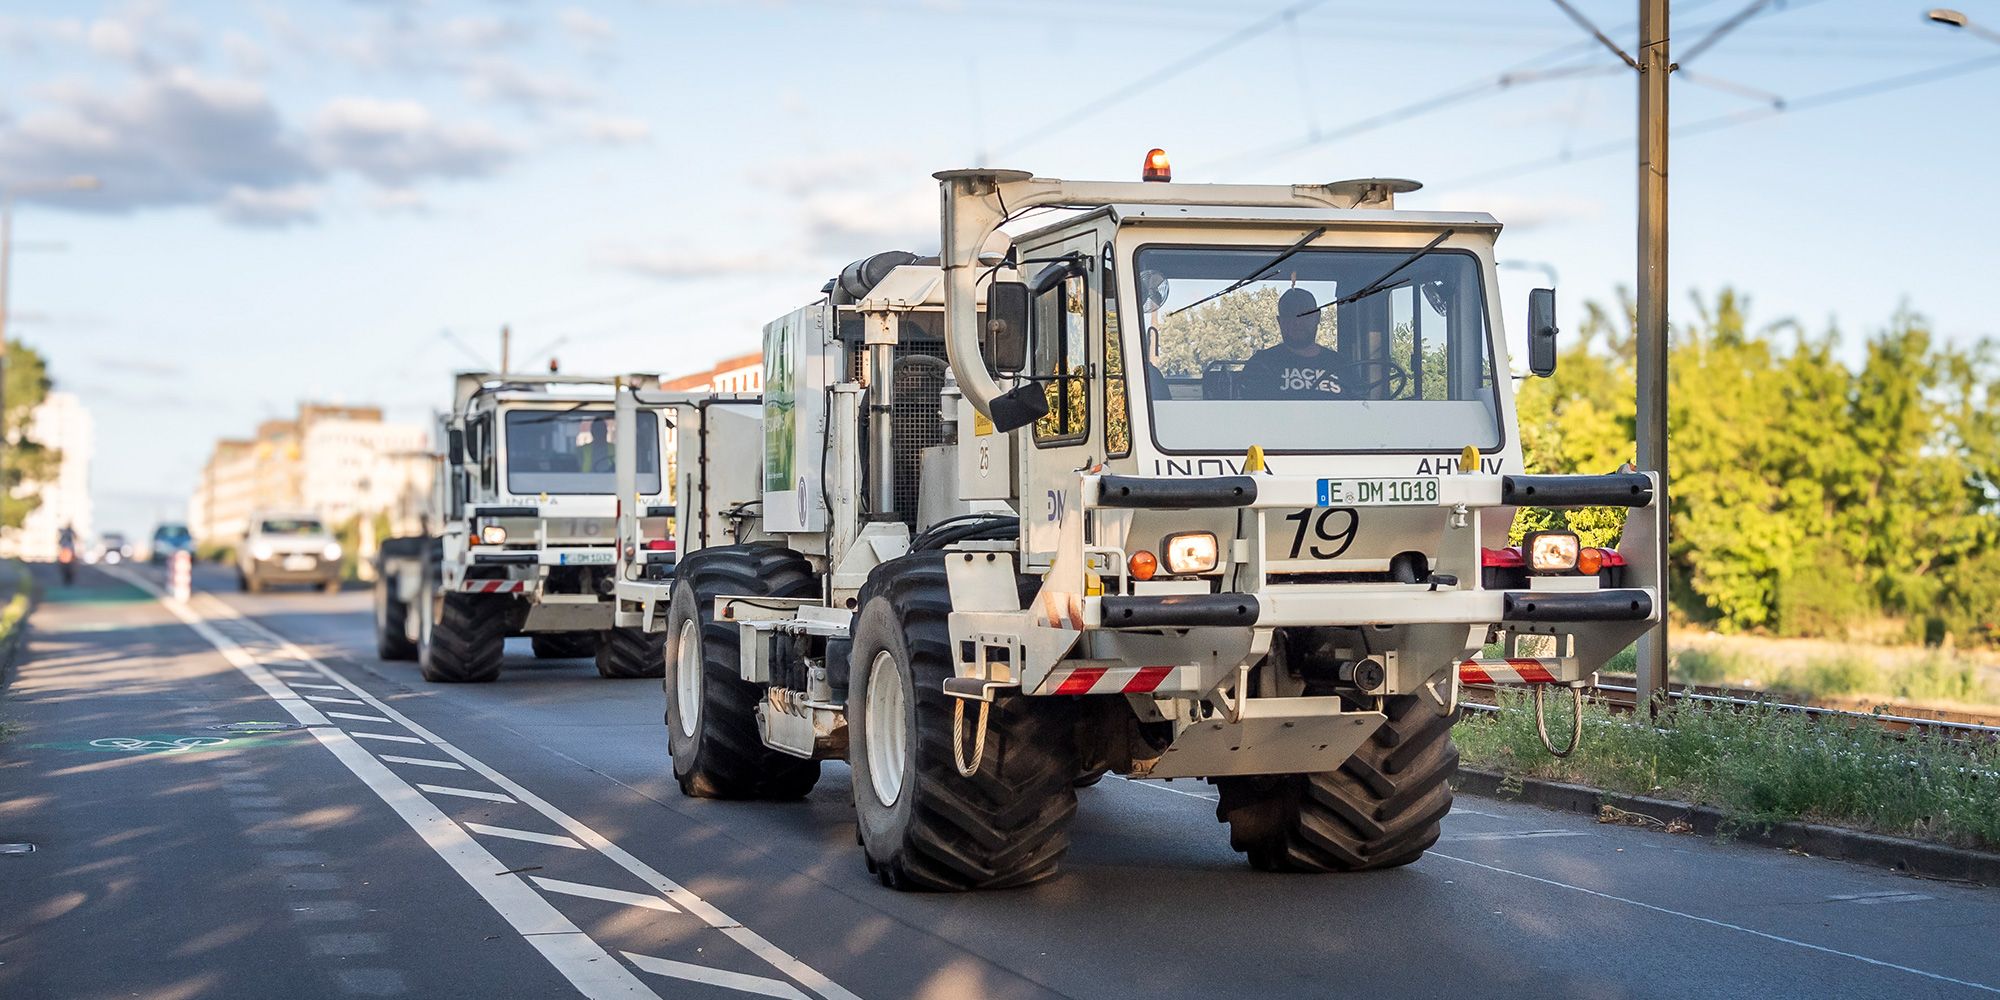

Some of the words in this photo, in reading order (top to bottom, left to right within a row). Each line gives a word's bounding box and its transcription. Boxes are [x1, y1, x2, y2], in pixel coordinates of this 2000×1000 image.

[980, 446, 989, 470] 25
[1331, 482, 1344, 503] E
[1358, 481, 1384, 503] DM
[1389, 480, 1437, 502] 1018
[1285, 507, 1360, 560] 19
